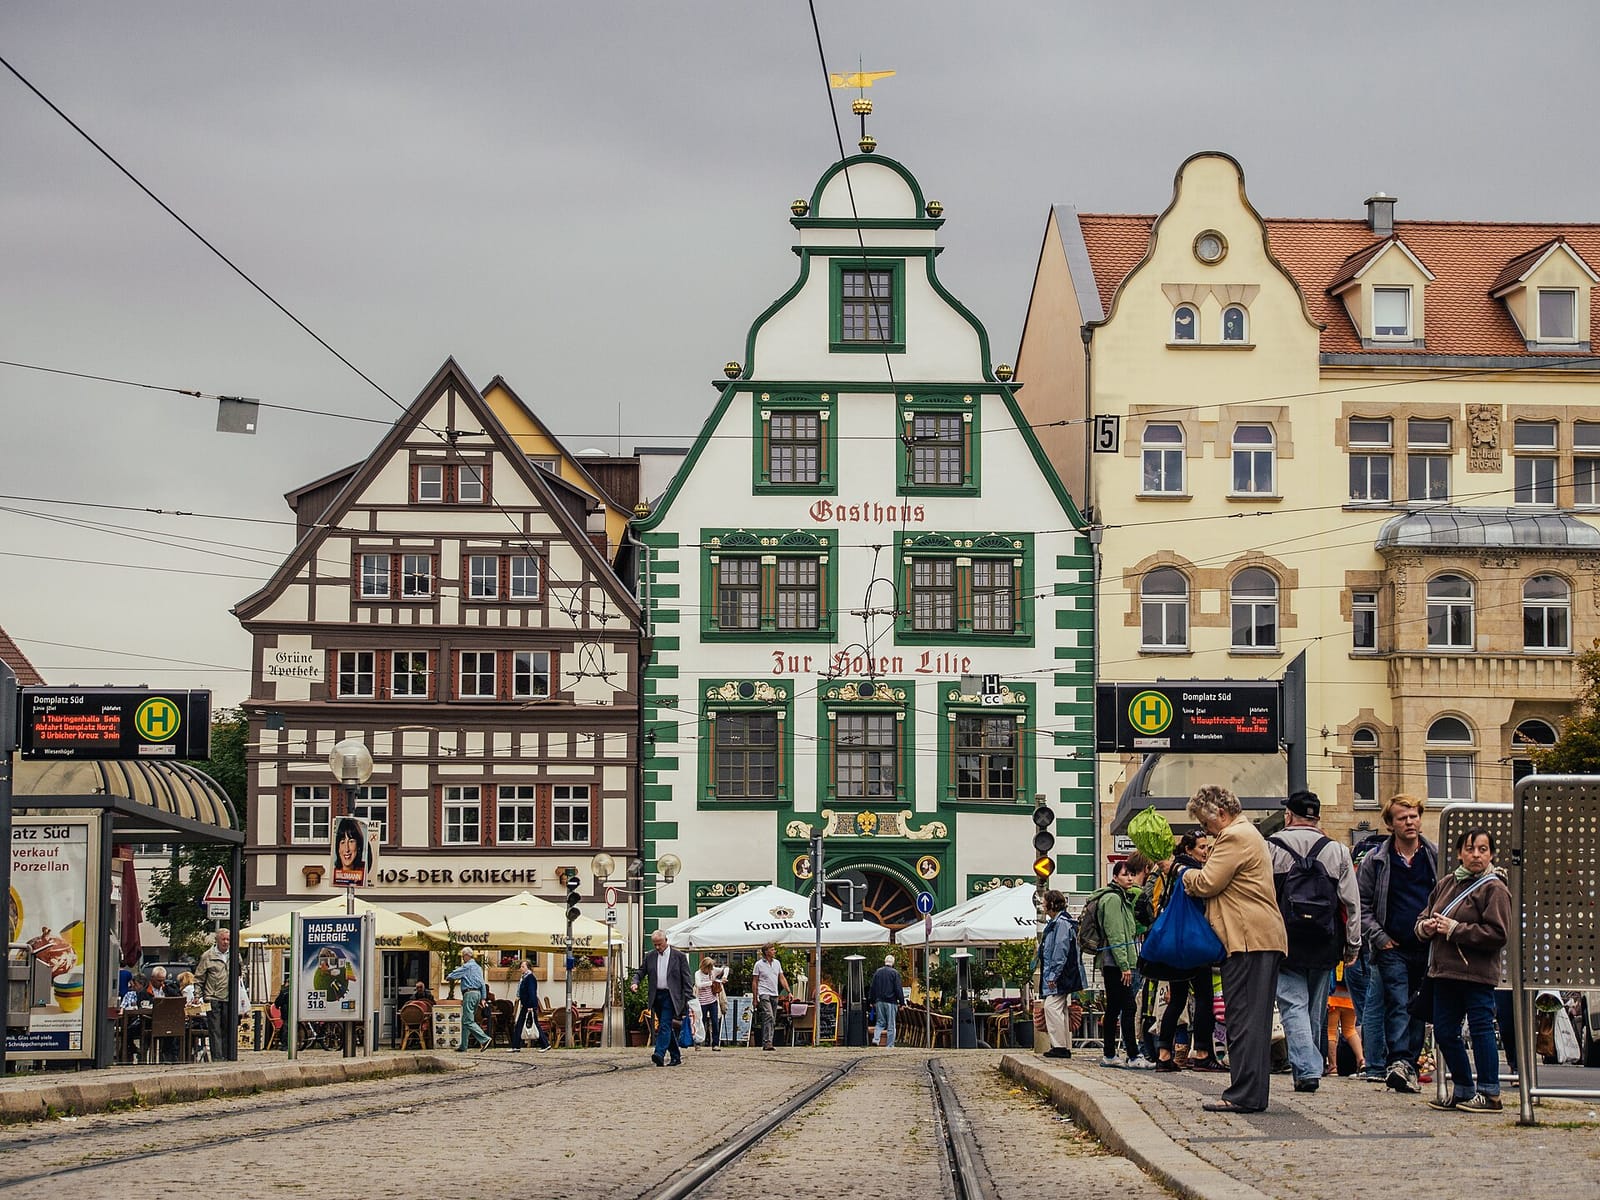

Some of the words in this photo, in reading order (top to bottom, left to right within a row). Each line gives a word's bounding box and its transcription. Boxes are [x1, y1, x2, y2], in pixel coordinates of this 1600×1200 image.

[1100, 420, 1113, 448] 5
[809, 500, 925, 524] Gasthaus
[276, 651, 312, 663] Grüne
[772, 651, 813, 674] Zur
[915, 650, 972, 674] Lilie
[268, 665, 319, 677] Apotheke
[986, 676, 997, 693] H
[33, 696, 68, 705] Domplatz
[70, 696, 84, 704] Süd
[1183, 693, 1216, 702] Domplatz
[1141, 700, 1160, 725] H
[47, 715, 100, 723] Thüringenhalle
[147, 707, 168, 732] H
[13, 827, 37, 839] atz
[43, 826, 70, 839] Süd
[12, 847, 59, 857] verkauf
[13, 861, 70, 872] Porzellan
[459, 869, 536, 883] GRIECHE
[308, 933, 349, 942] ENERGIE.
[550, 934, 592, 946] Rieeck
